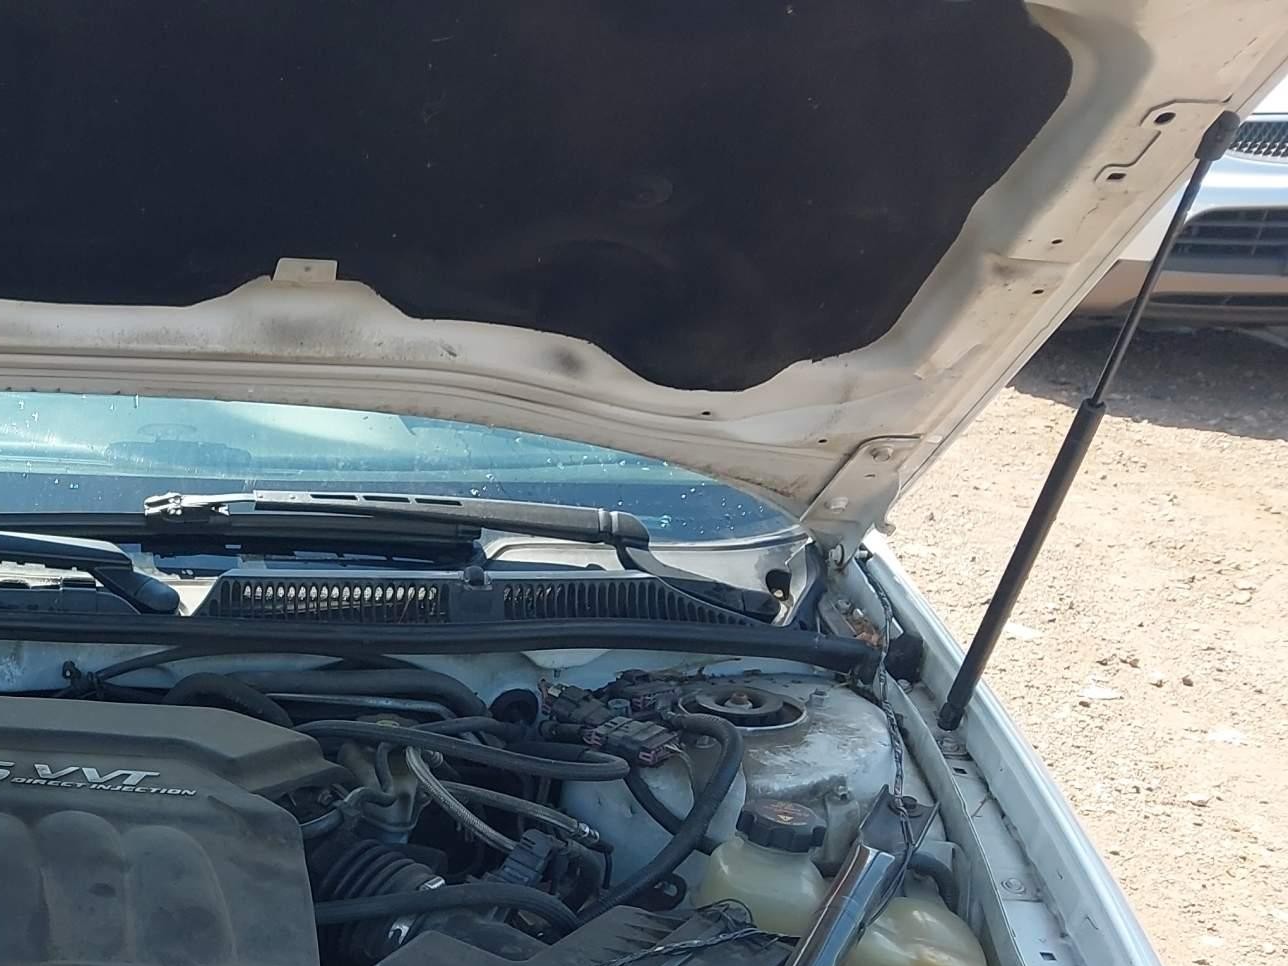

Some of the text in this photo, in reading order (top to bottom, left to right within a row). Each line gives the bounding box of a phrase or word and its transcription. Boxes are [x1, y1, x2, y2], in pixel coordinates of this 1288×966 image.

[32, 763, 161, 785] VVT
[10, 777, 198, 797] DIRECT INJECTION
